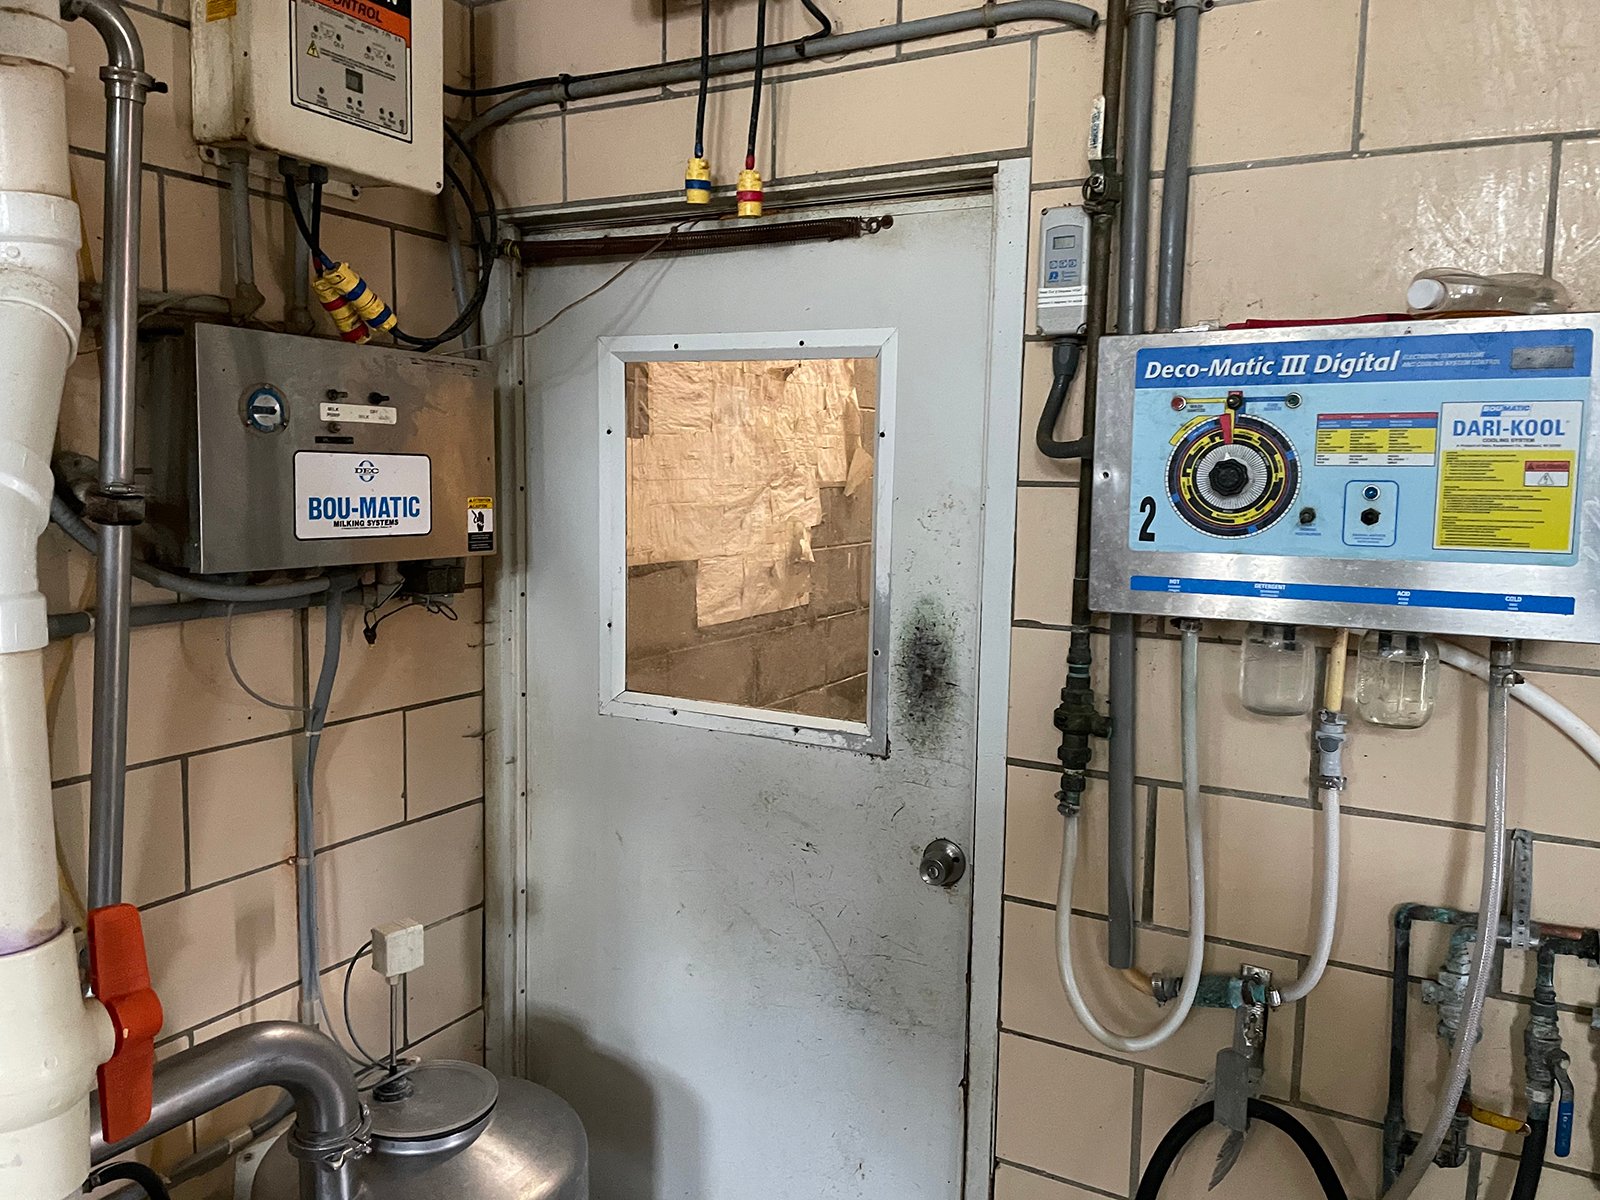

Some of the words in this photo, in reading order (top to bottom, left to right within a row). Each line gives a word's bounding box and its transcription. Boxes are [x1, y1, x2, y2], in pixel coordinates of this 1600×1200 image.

[327, 0, 383, 24] NTROL
[1144, 357, 1275, 379] Deco-Matic
[1277, 354, 1310, 376] III
[1313, 350, 1401, 378] Digital
[1453, 419, 1566, 436] DARI-KOOL
[308, 496, 420, 520] BOU-MATIC
[1138, 495, 1157, 542] 2
